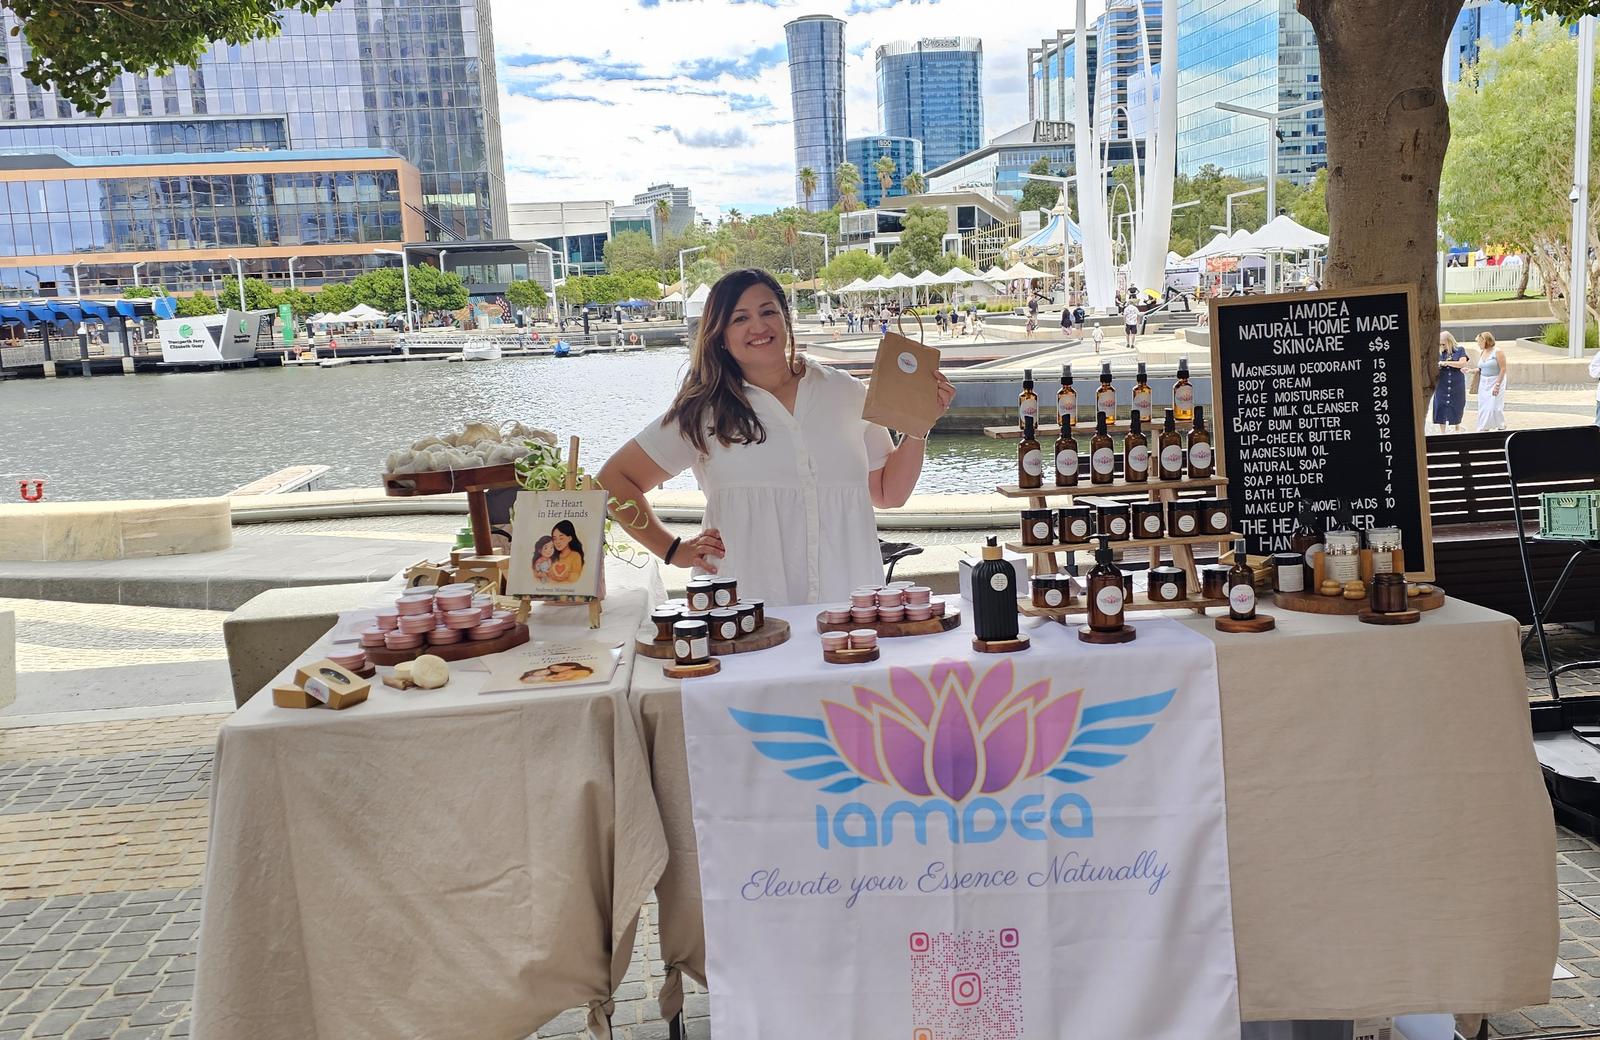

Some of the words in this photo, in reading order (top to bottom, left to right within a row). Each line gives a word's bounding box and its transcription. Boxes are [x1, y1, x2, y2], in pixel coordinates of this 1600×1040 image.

[1239, 322, 1303, 341] NATURAL
[1308, 318, 1351, 336] HOME
[1356, 314, 1399, 332] MADE
[1272, 335, 1345, 355] SKINCARE
[1368, 336, 1390, 352] $$$
[1231, 362, 1296, 378] MAGNESIUM
[1299, 359, 1362, 374] DEODORANT
[1373, 358, 1386, 369] 15
[1238, 379, 1266, 392] BODY
[1272, 377, 1312, 388] CREAM
[1373, 372, 1387, 383] 26
[1237, 393, 1268, 405] FACE
[1274, 388, 1345, 402] MOISTURISER
[1373, 386, 1388, 397] 28
[1238, 406, 1266, 418] FACE
[1272, 405, 1298, 417] MILK
[1302, 402, 1360, 415] CLEANSER
[1374, 400, 1389, 412] 24
[1232, 417, 1262, 433] BABY
[1268, 419, 1292, 431] BUM
[1299, 416, 1341, 429] BUTTER
[1376, 414, 1391, 426] 30
[1240, 432, 1304, 446] LIP-CHEEK
[1308, 430, 1351, 442] BUTTER
[1379, 428, 1391, 439] 12
[1240, 446, 1307, 460] MAGNESIUM
[1311, 444, 1329, 456] OIL
[1379, 441, 1392, 452] 10
[1243, 460, 1294, 473] NATURAL
[1299, 458, 1327, 470] SOAP
[1385, 455, 1393, 466] 7
[1243, 474, 1272, 487] SOAP
[1276, 472, 1324, 485] HOLDER
[1385, 469, 1393, 480] 7
[1245, 488, 1275, 500] BATH
[1279, 488, 1301, 499] TEA
[1384, 483, 1392, 494] 4
[546, 499, 560, 508] The
[561, 499, 583, 508] Heart
[1245, 501, 1294, 515] MAKEUP
[1385, 497, 1396, 509] 10
[547, 510, 562, 518] Her
[564, 509, 589, 518] Hands
[1240, 518, 1269, 535] THE
[741, 867, 842, 901] Elevate
[845, 873, 909, 909] your
[917, 861, 1020, 893] Essence
[1027, 850, 1171, 896] Naturally
